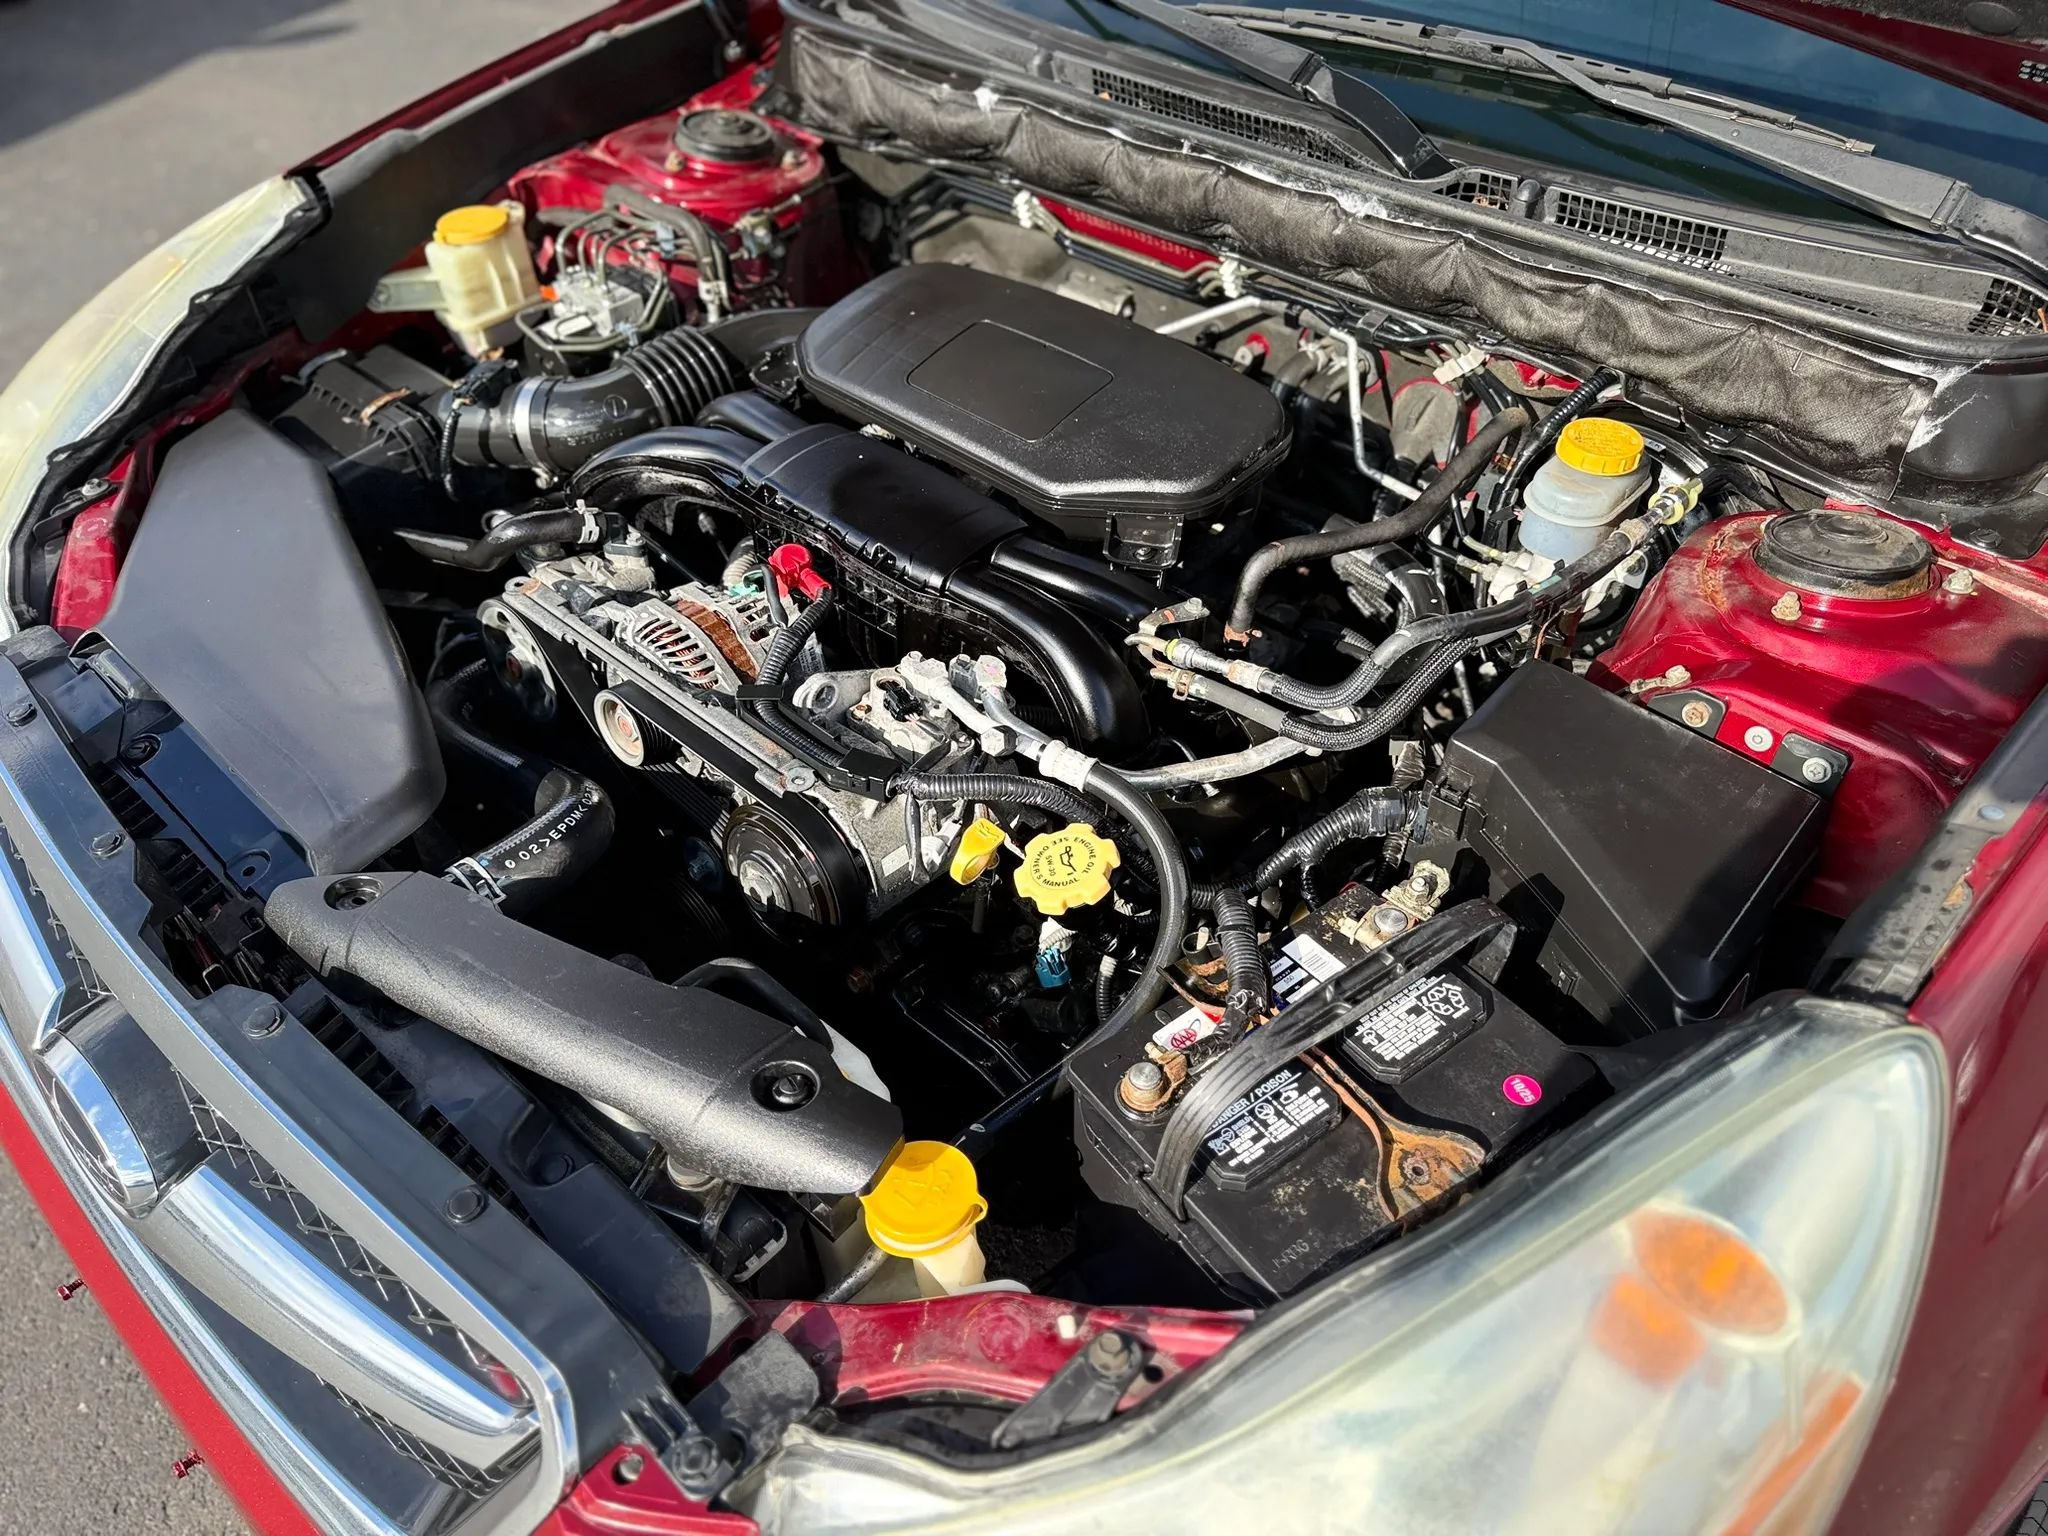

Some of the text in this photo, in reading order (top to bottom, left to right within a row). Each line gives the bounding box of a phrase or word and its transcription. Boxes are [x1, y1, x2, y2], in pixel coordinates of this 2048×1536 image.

[1045, 854, 1056, 876] 5W-30
[1073, 836, 1096, 873] ENGINE OIL
[1041, 877, 1079, 887] MANUAL
[1172, 1028, 1197, 1049] AAA
[1255, 1070, 1292, 1097] POISON
[1511, 1078, 1536, 1102] 10/25
